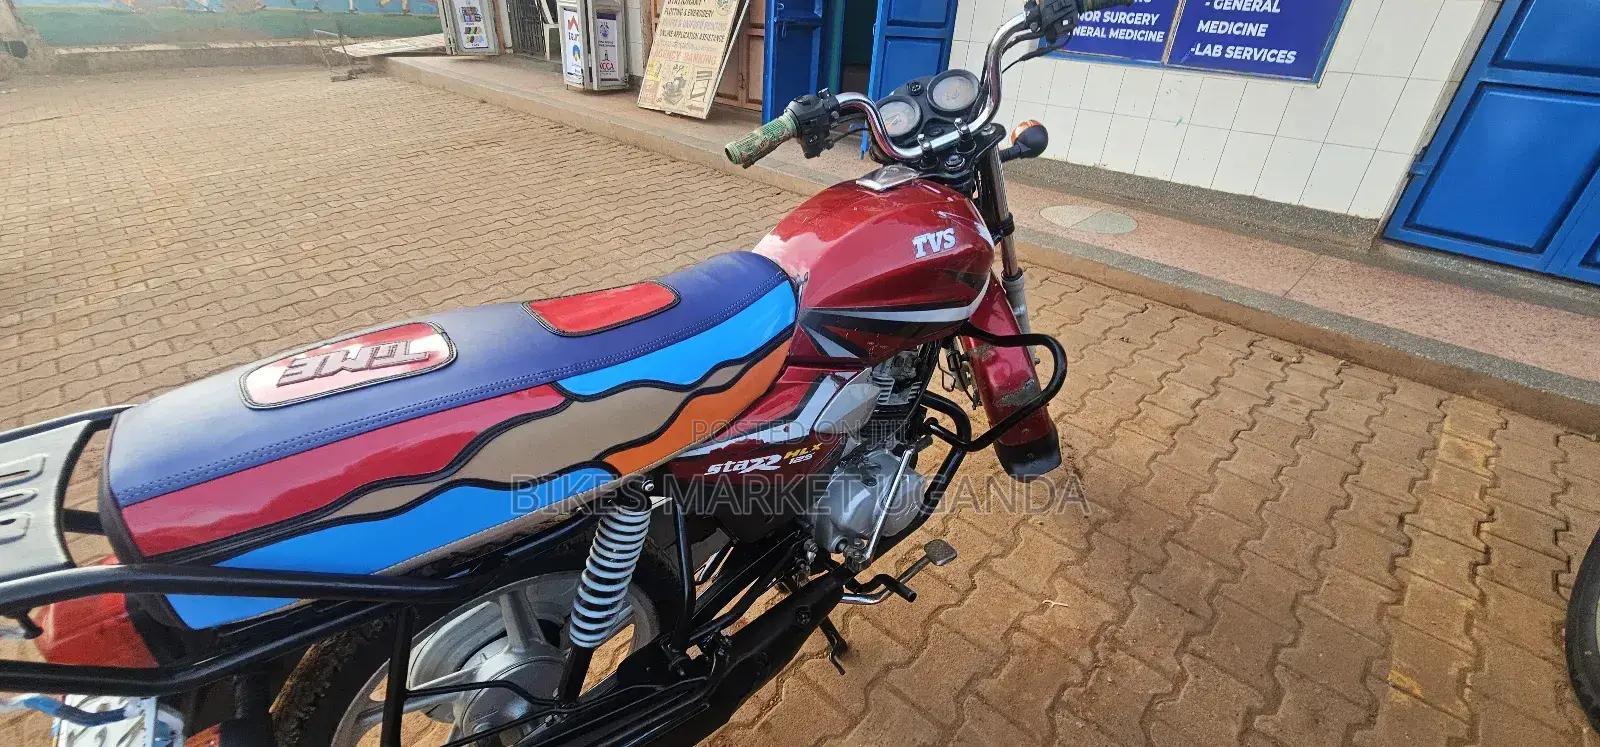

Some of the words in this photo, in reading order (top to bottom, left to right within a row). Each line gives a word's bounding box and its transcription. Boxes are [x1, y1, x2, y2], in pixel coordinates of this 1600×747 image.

[1213, 0, 1281, 13] GENERAL
[1102, 11, 1160, 26] SURGERY
[1072, 26, 1106, 38] NERAL
[1108, 29, 1165, 42] MEDICINE
[1197, 20, 1269, 37] MEDICINE
[673, 31, 699, 40] APPLICATION
[699, 33, 725, 43] ASSISTANCE
[685, 52, 718, 65] BANKING
[1190, 43, 1223, 57] -LAB
[1224, 46, 1297, 64] SERVICES
[912, 228, 957, 259] TVS
[784, 443, 823, 459] HLX
